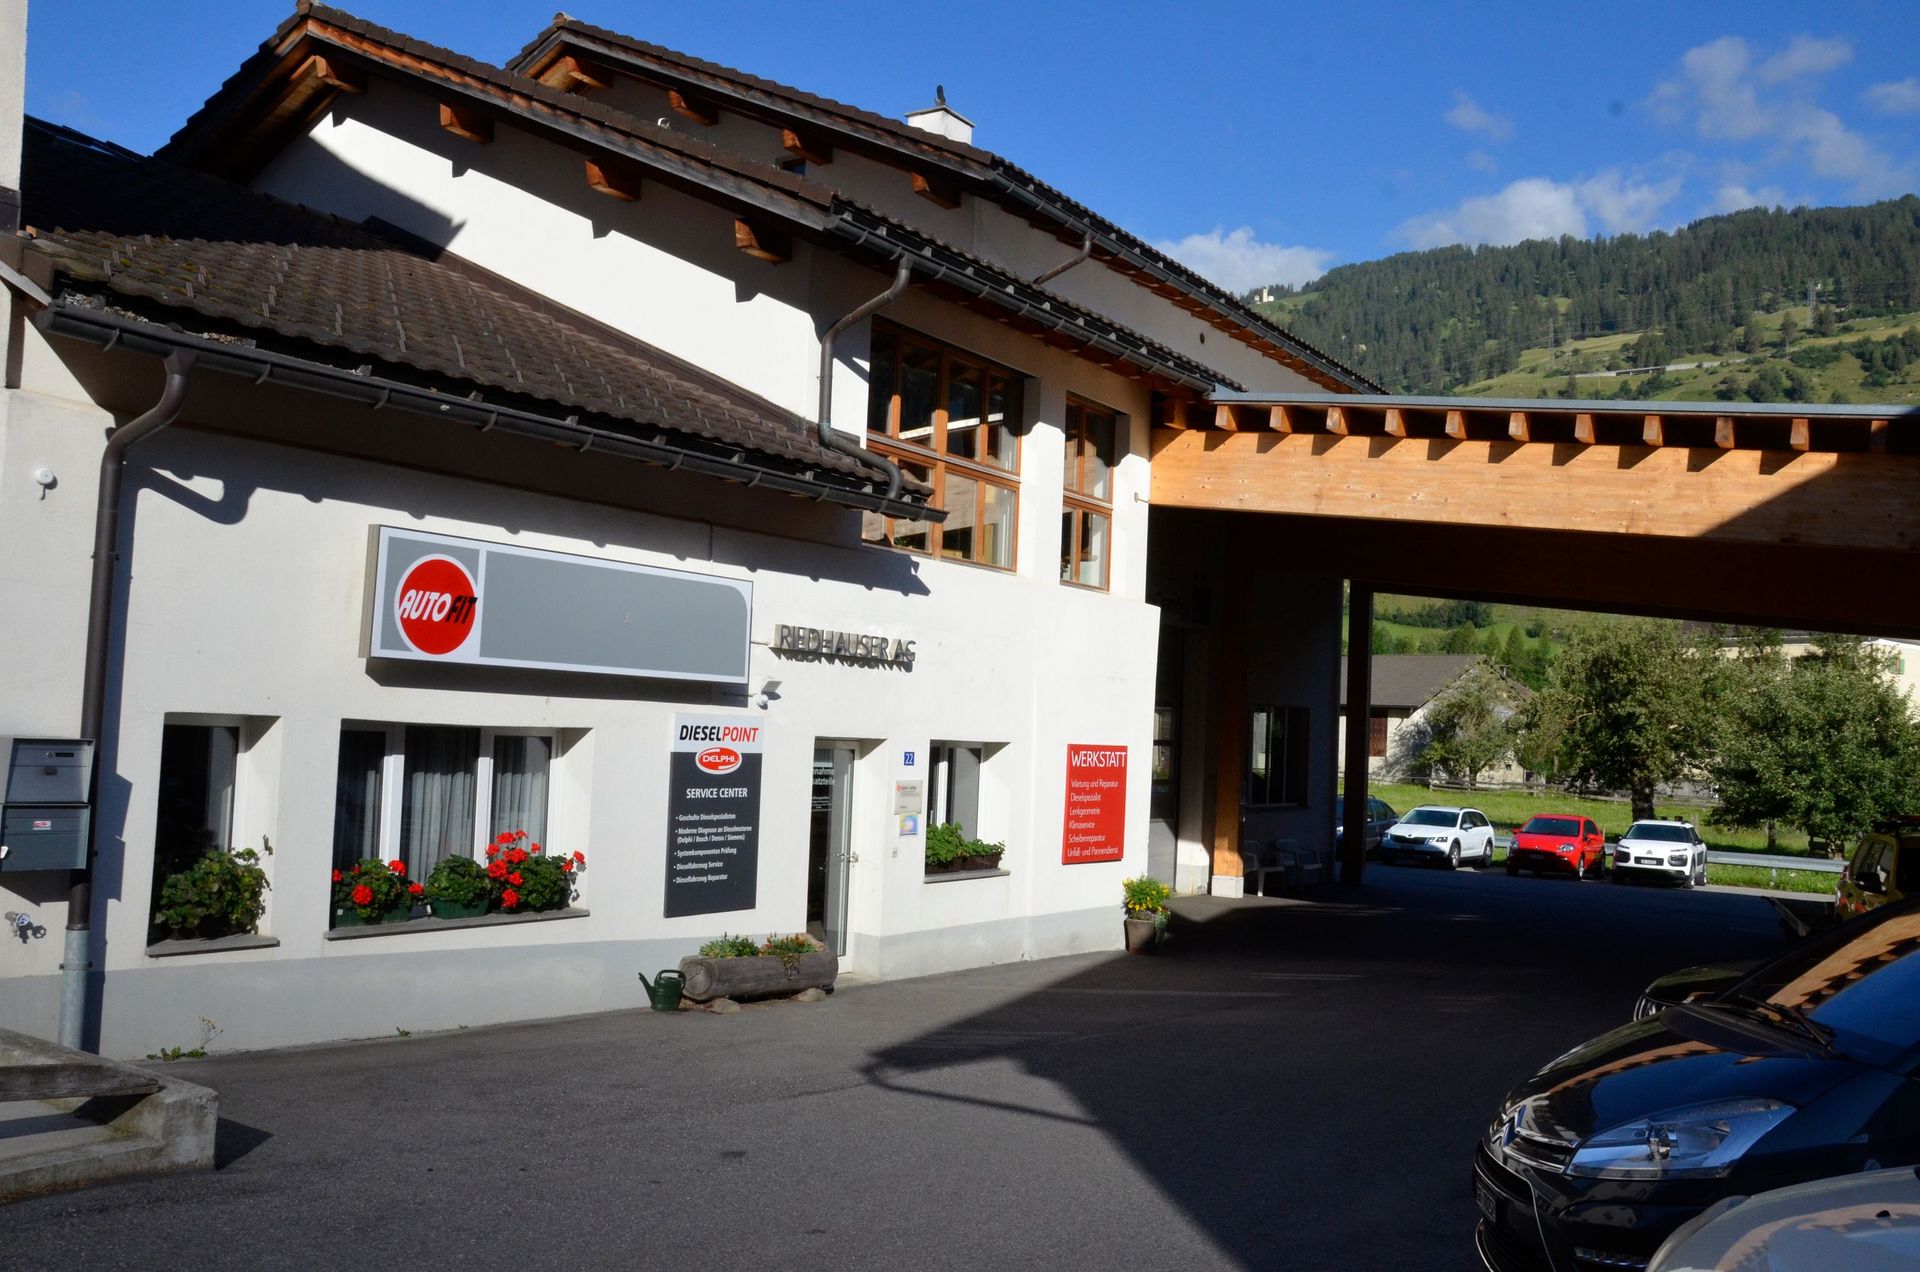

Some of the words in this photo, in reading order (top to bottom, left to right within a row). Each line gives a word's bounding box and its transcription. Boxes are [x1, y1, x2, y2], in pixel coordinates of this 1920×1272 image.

[399, 588, 478, 625] AUTOFIT
[776, 624, 889, 660] RIEDHAUSER
[892, 638, 916, 662] AG
[679, 724, 759, 742] DIESELPOINT
[702, 755, 735, 763] DELPHI
[905, 753, 914, 765] 22
[1071, 750, 1127, 768] WERKSTATT
[1090, 779, 1099, 788] und
[1099, 778, 1119, 789] Reparatur
[686, 788, 718, 799] SERVICE
[719, 787, 748, 798] CENTER
[697, 826, 717, 835] Diagnose
[695, 835, 708, 843] Bosch
[1081, 846, 1091, 856] und
[707, 874, 728, 882] Reparatur
